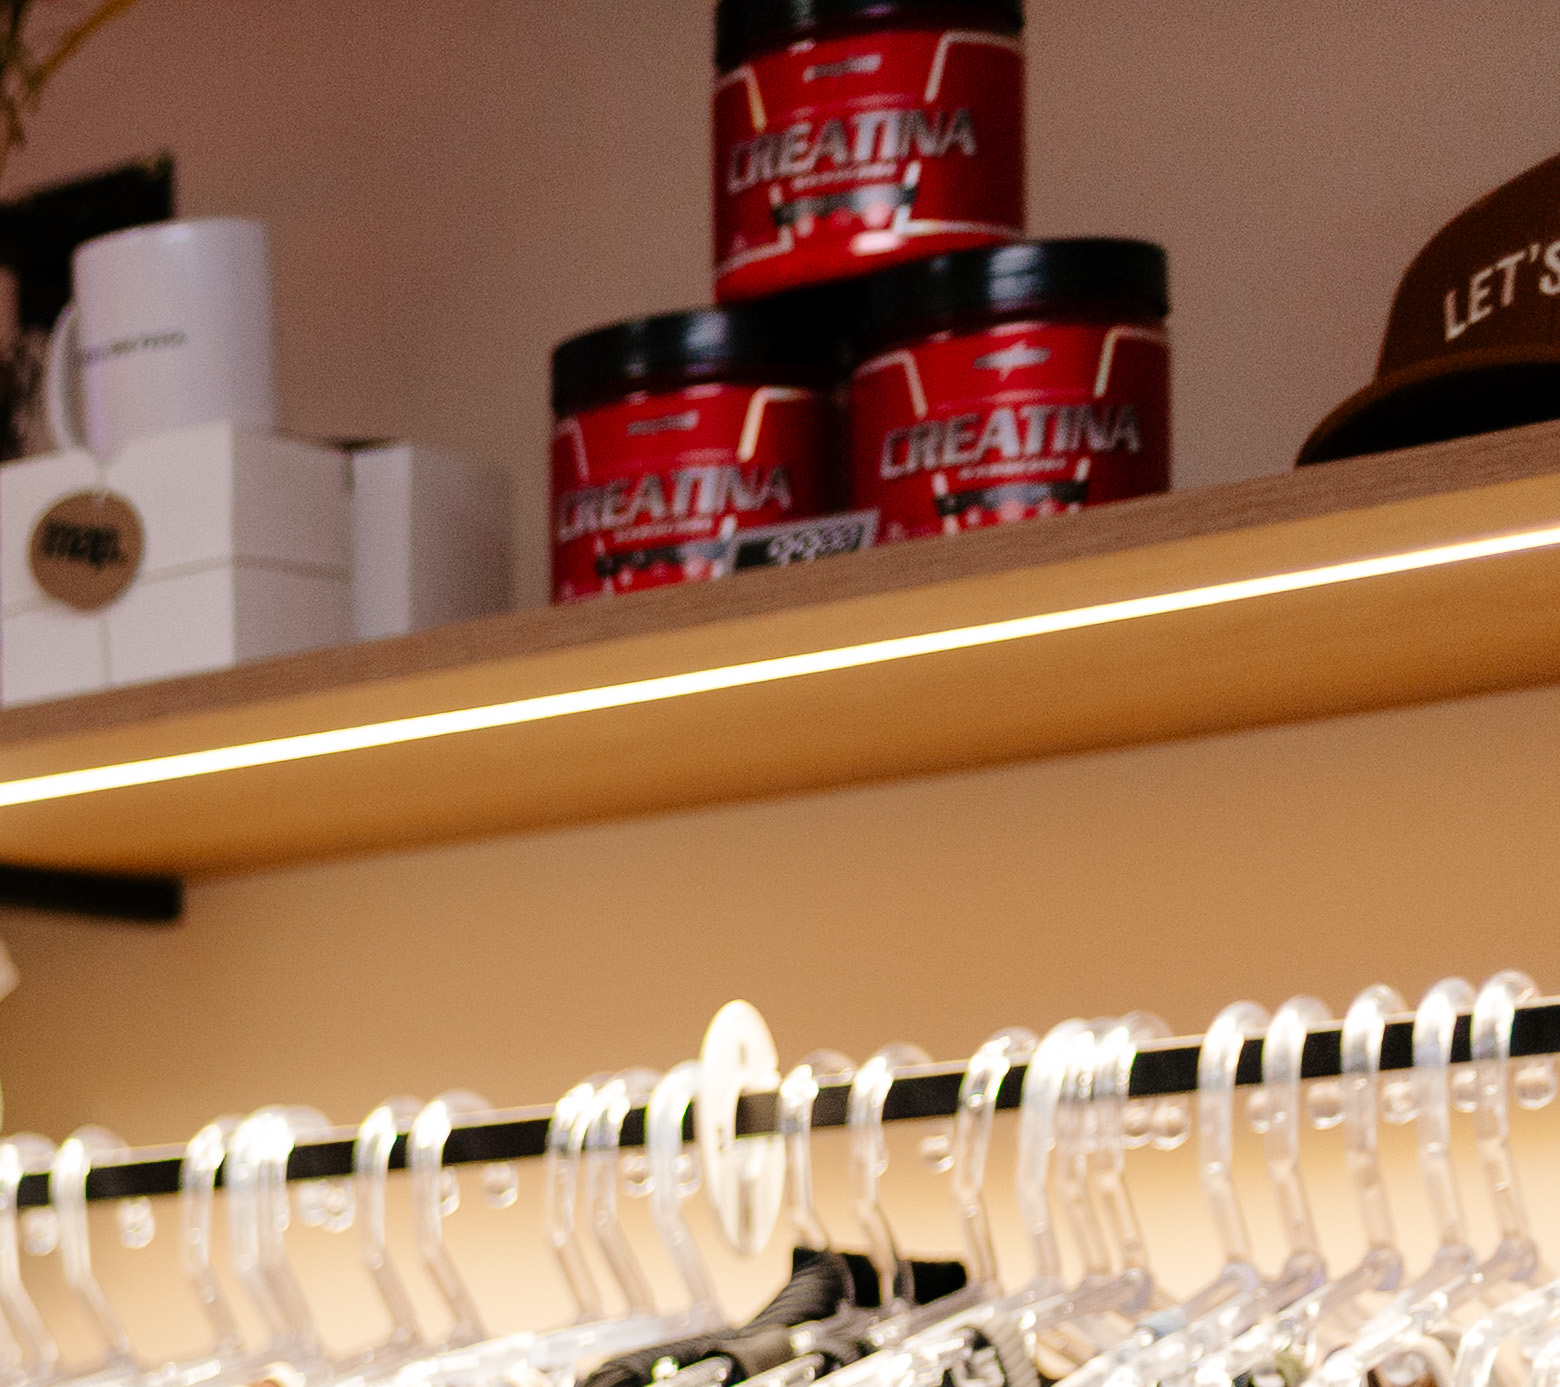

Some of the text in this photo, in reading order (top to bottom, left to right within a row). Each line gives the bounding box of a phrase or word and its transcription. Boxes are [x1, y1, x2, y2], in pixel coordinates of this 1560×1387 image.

[727, 108, 976, 194] CREATINA
[878, 402, 1141, 480] CREATINA
[558, 463, 792, 544] CREATINA
